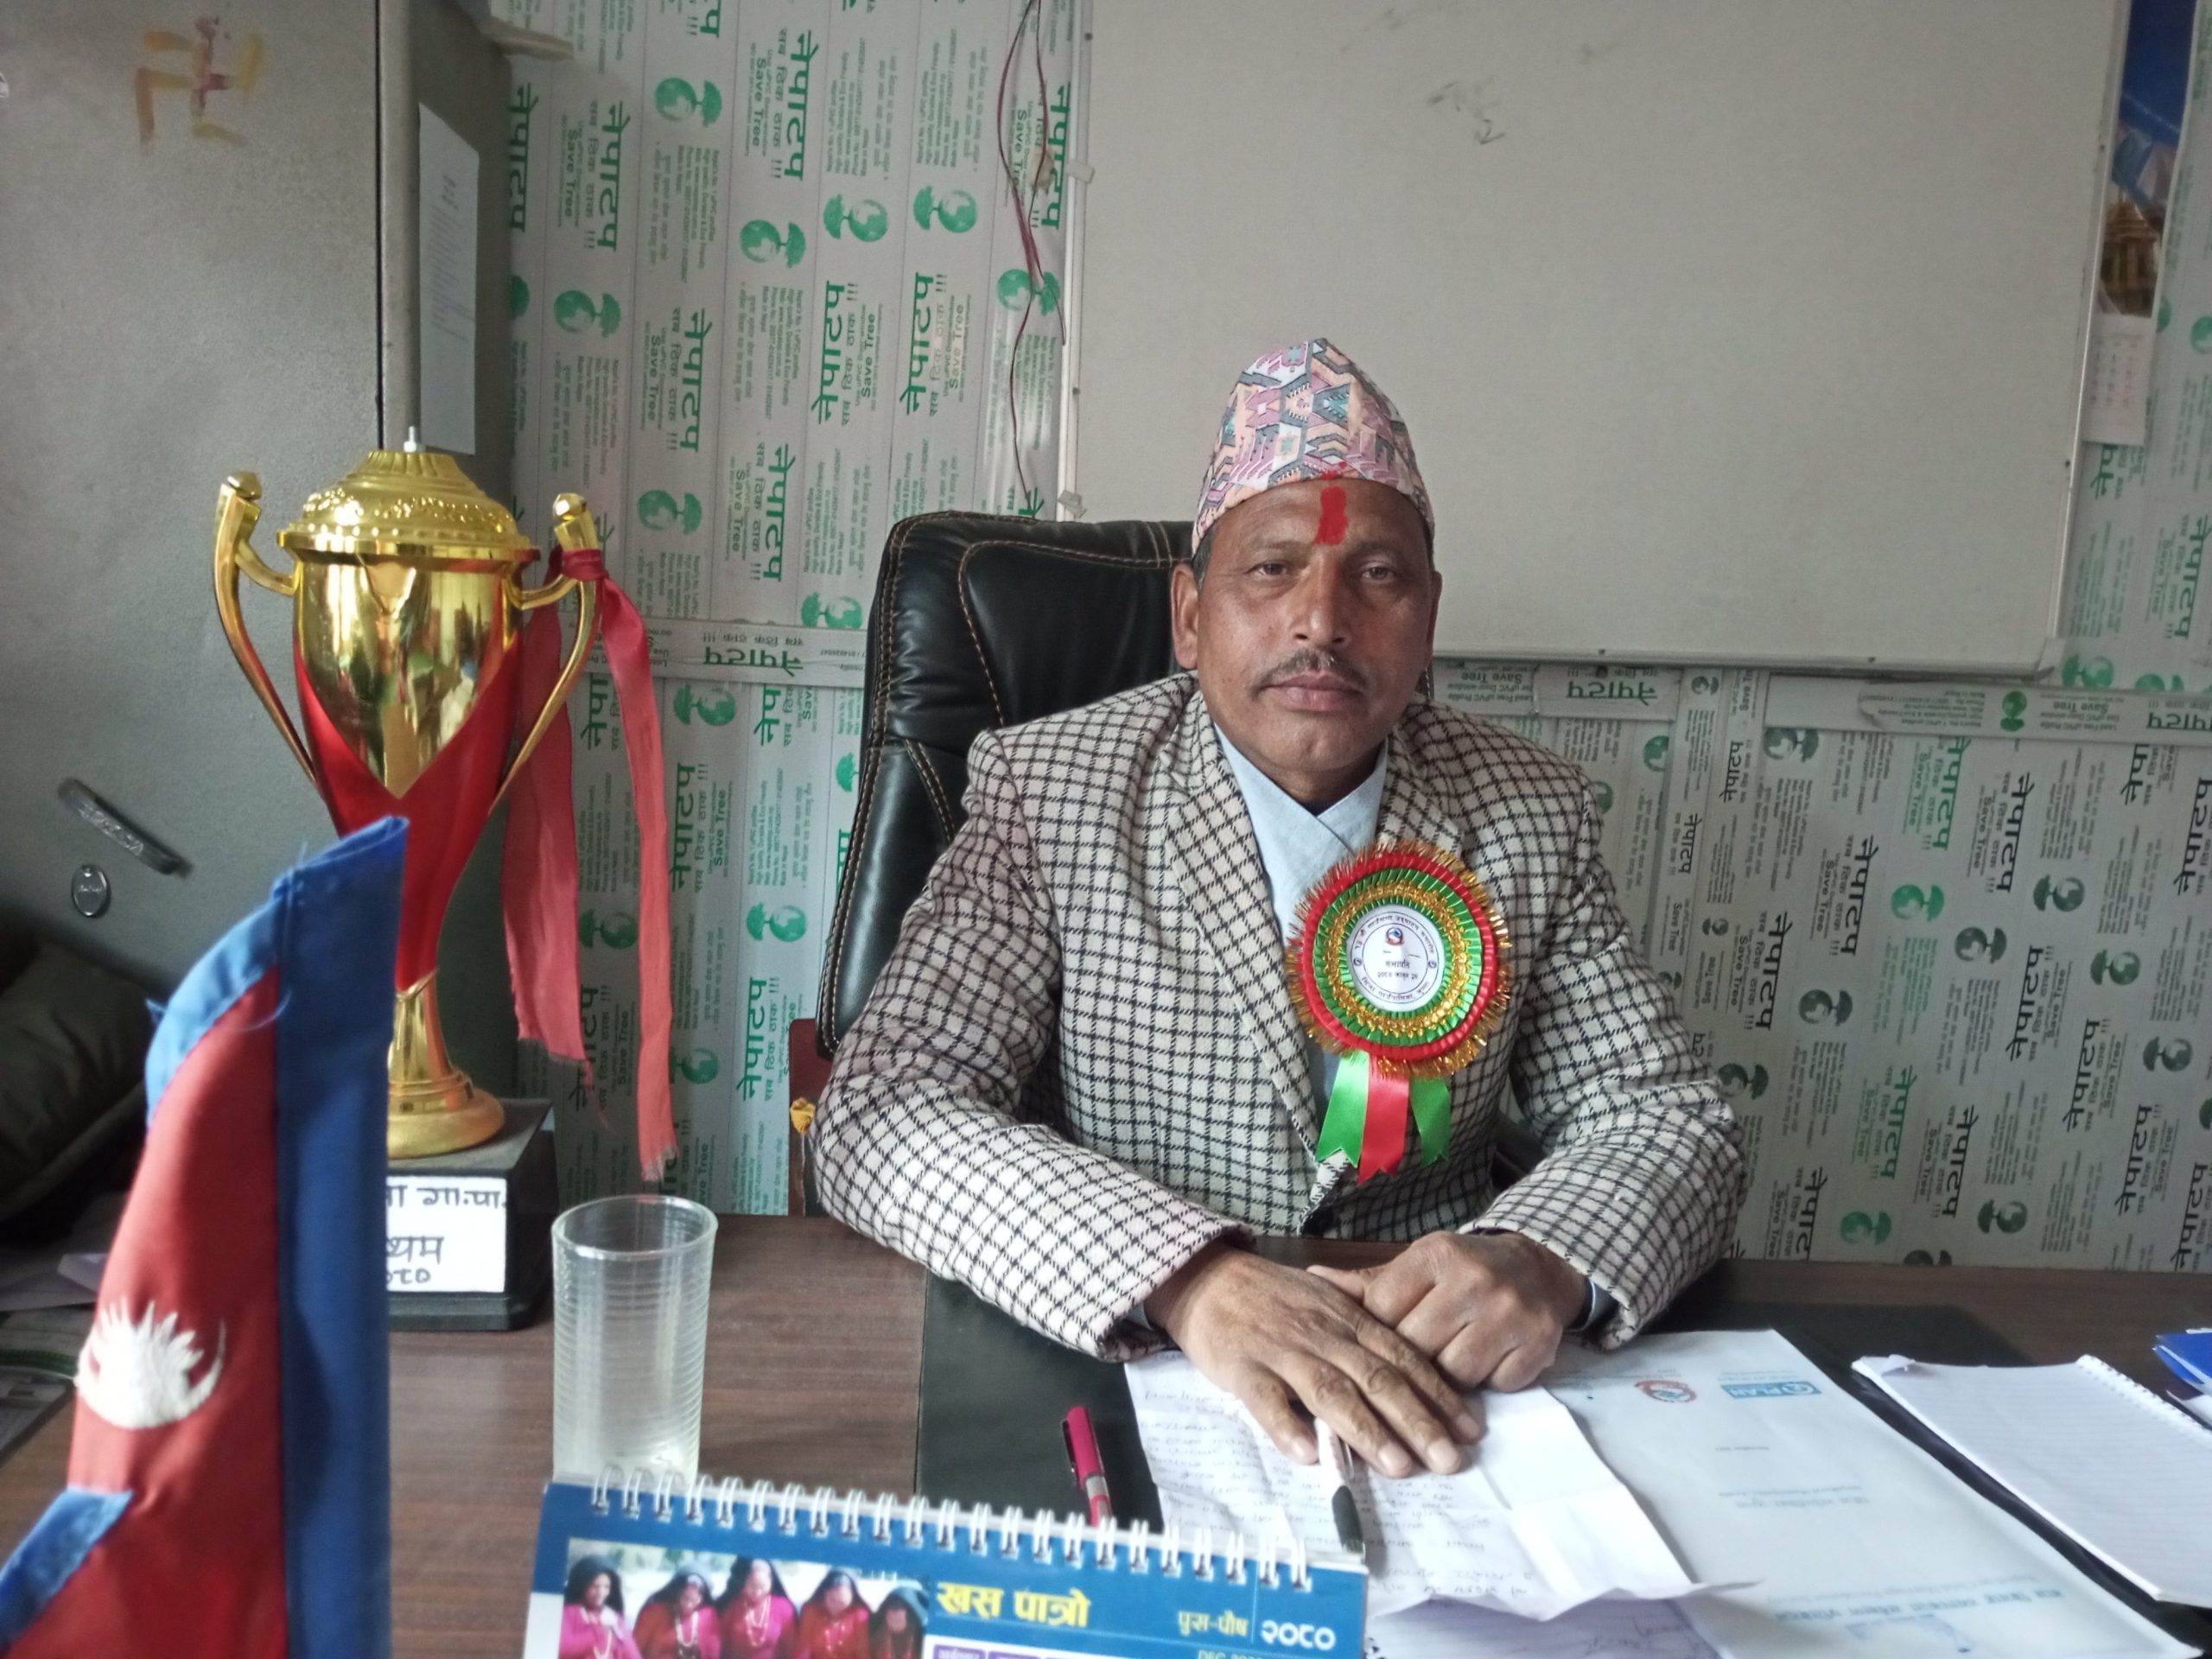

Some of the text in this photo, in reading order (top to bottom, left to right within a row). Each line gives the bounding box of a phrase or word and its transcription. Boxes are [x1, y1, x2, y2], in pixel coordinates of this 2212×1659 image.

[752, 58, 766, 147] Save Tree
[784, 30, 820, 181] नेपाटप
[564, 130, 577, 217] Save Tree
[596, 101, 632, 251] नेपाटप
[647, 335, 661, 421] Save Tree
[678, 308, 713, 453] नेपाटप
[810, 280, 845, 424] नेपाटप
[861, 314, 875, 397] Save Tree
[899, 272, 934, 415] नेपाटप
[949, 304, 964, 389] Save Tree
[732, 470, 745, 552] Save Tree
[762, 443, 797, 582] नेपाटप
[703, 646, 804, 677] नेपाटप
[802, 686, 813, 720] Sav
[1461, 673, 1522, 684] Save Tree
[1566, 681, 1658, 706] नेपाटप
[664, 763, 696, 893] नेपाटप
[713, 790, 726, 866] Save Tree
[1996, 772, 2035, 893] नेपाटप
[1840, 836, 1879, 956] नेपाटप
[1755, 912, 1794, 1031] नेपाटप
[2005, 945, 2044, 1061] नेपाटप
[735, 977, 767, 1100] नेपाटप
[2062, 1018, 2101, 1132] नेपाटप
[1941, 1105, 1980, 1218] नेपाटप
[2114, 1104, 2153, 1215] नेपाटप
[937, 1581, 1091, 1628] खस पात्रो
[1261, 1619, 1337, 1651] २०८०
